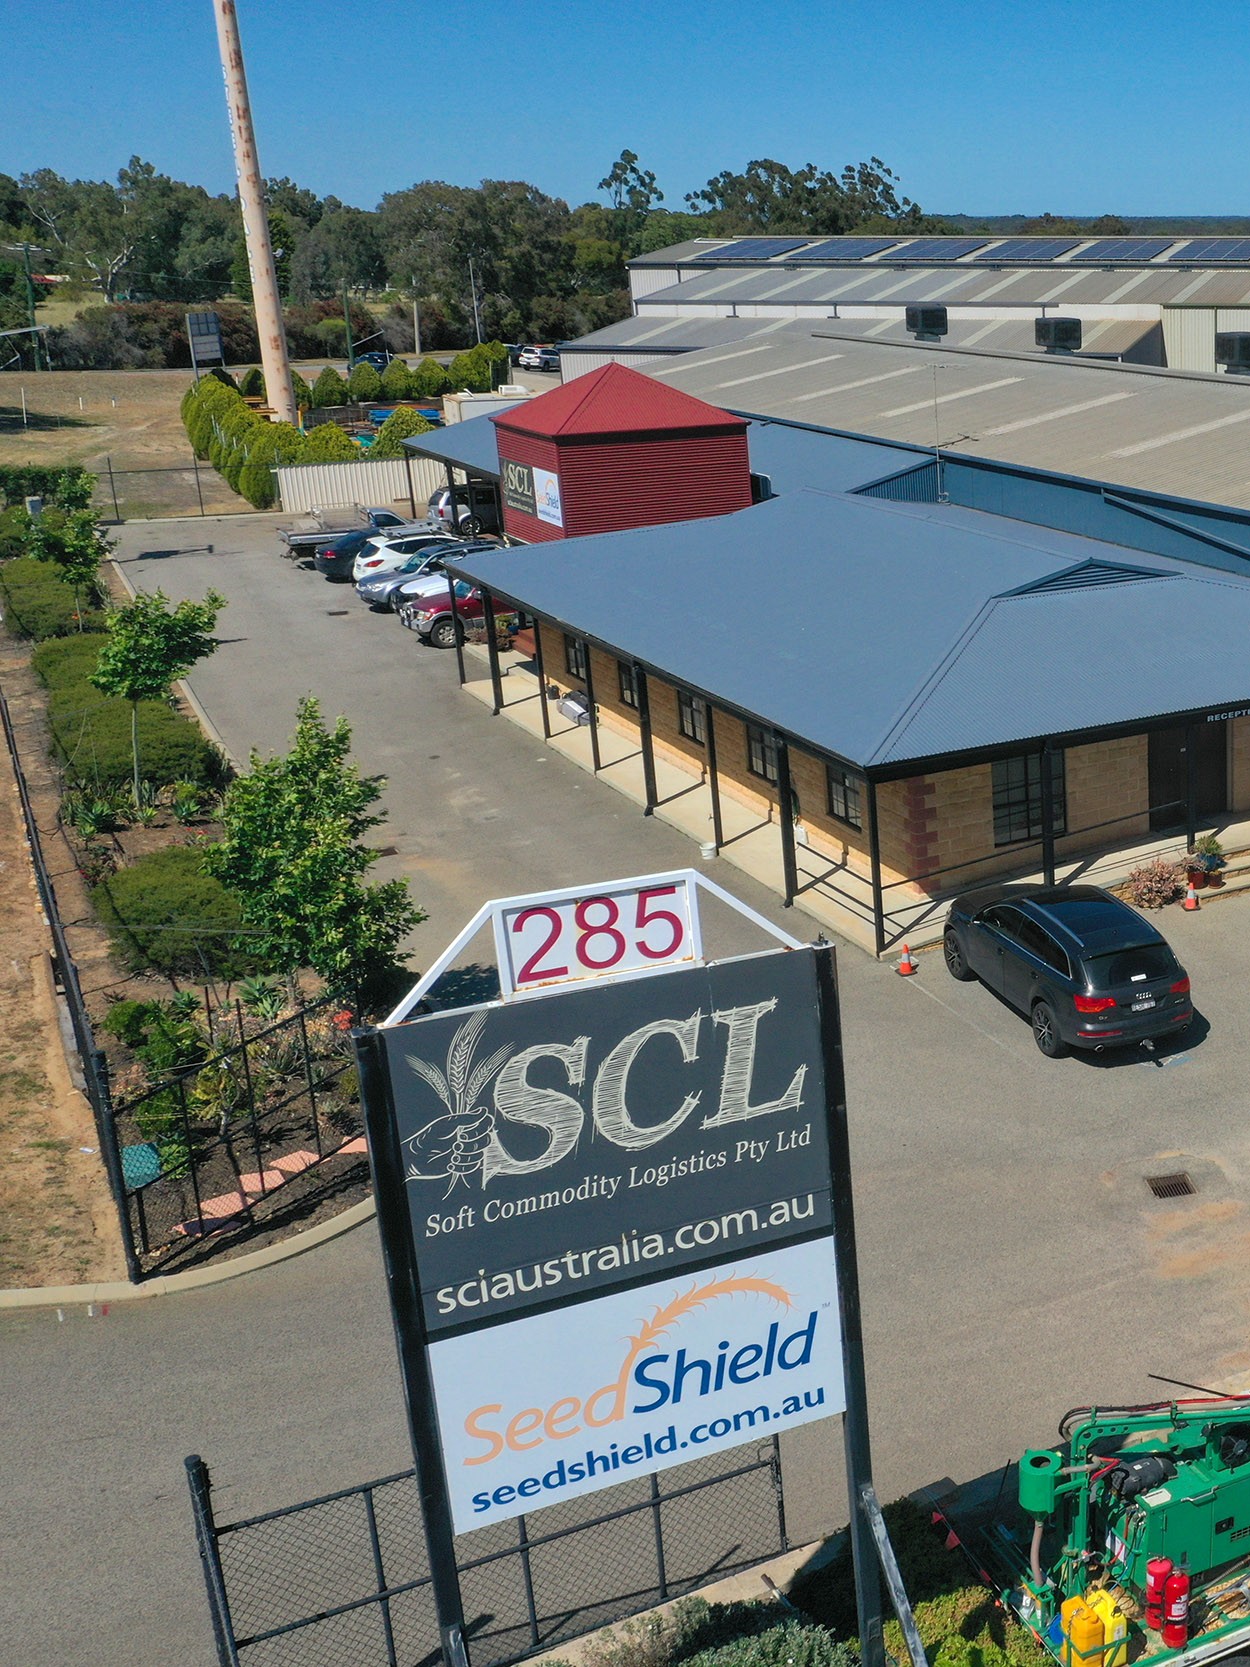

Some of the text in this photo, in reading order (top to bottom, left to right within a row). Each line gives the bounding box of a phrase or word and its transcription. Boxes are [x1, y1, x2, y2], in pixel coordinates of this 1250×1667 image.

[508, 463, 532, 496] SCL
[512, 886, 684, 984] 285
[481, 996, 808, 1190] SCL
[425, 1123, 812, 1238] Soft Commodity Logistics Pty Ltd
[463, 1310, 819, 1467] SeedShield
[471, 1387, 826, 1514] seedshield.com.au
